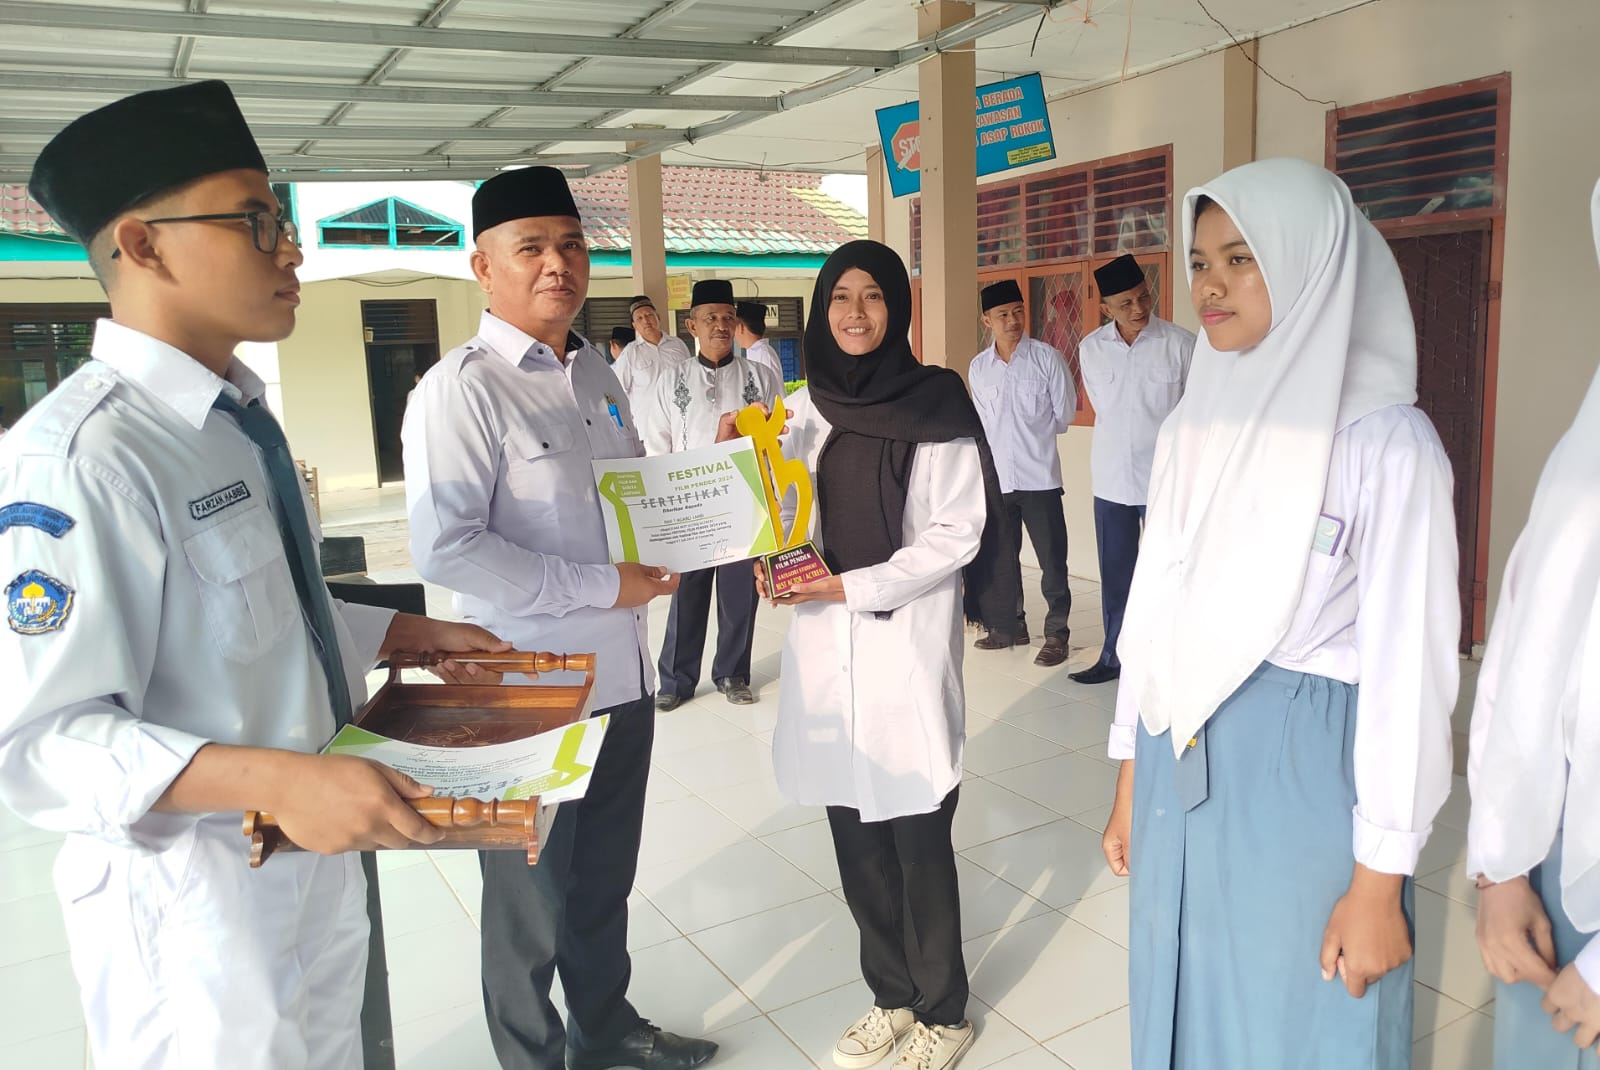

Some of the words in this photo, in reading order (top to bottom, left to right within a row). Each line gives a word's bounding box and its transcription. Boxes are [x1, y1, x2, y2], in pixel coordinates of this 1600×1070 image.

[982, 87, 1024, 108] BERADA
[981, 129, 1008, 146] ASAP
[1011, 119, 1046, 139] ROKOK
[669, 461, 733, 481] FESTIVAL
[690, 479, 716, 488] PENDEK
[640, 485, 729, 509] SERTIFIKAT
[775, 560, 790, 570] FILM
[790, 553, 812, 566] PENDEK
[778, 548, 805, 561] FESTIVAL
[775, 581, 787, 590] BEST
[787, 575, 803, 586] ACTOR
[805, 568, 826, 580] ACTRESS
